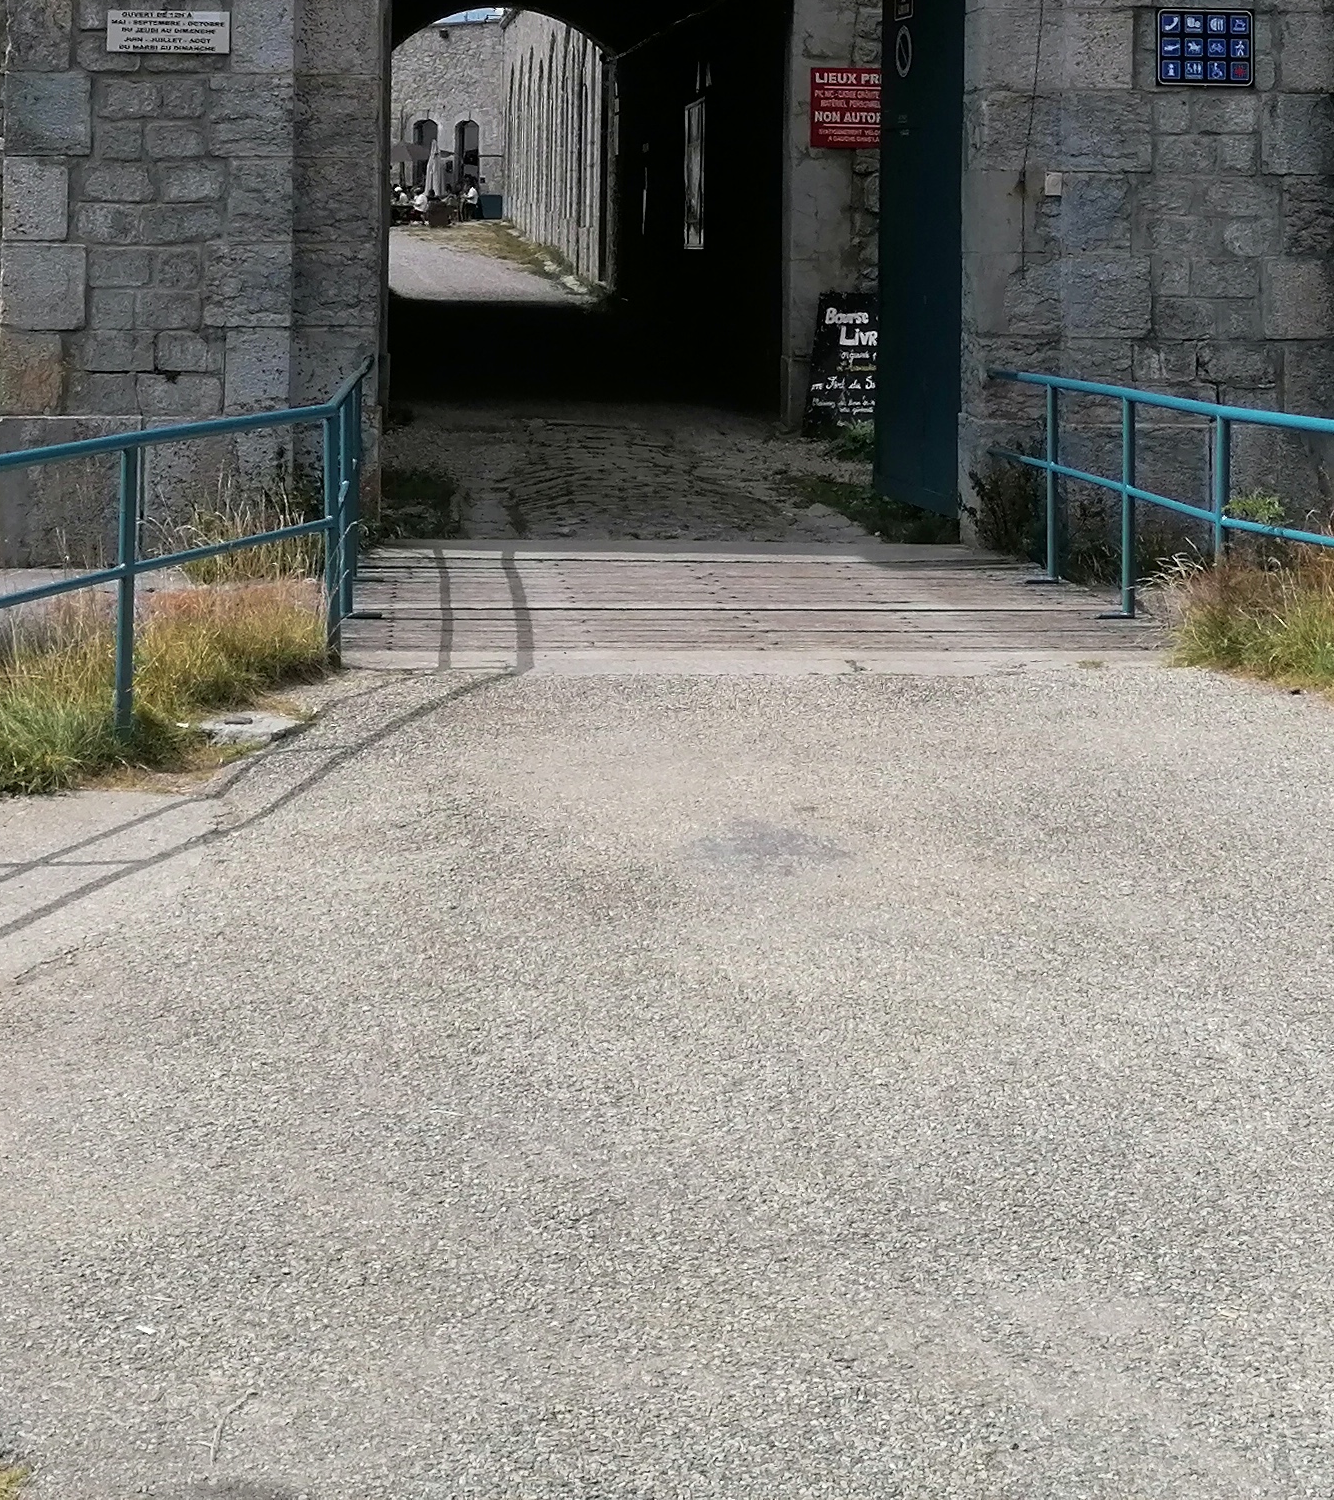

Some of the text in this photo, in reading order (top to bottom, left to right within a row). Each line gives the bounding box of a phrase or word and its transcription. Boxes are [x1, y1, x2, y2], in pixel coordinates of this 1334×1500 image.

[815, 72, 857, 84] LIEUX
[814, 111, 841, 122] NON
[825, 307, 869, 324] Bourse
